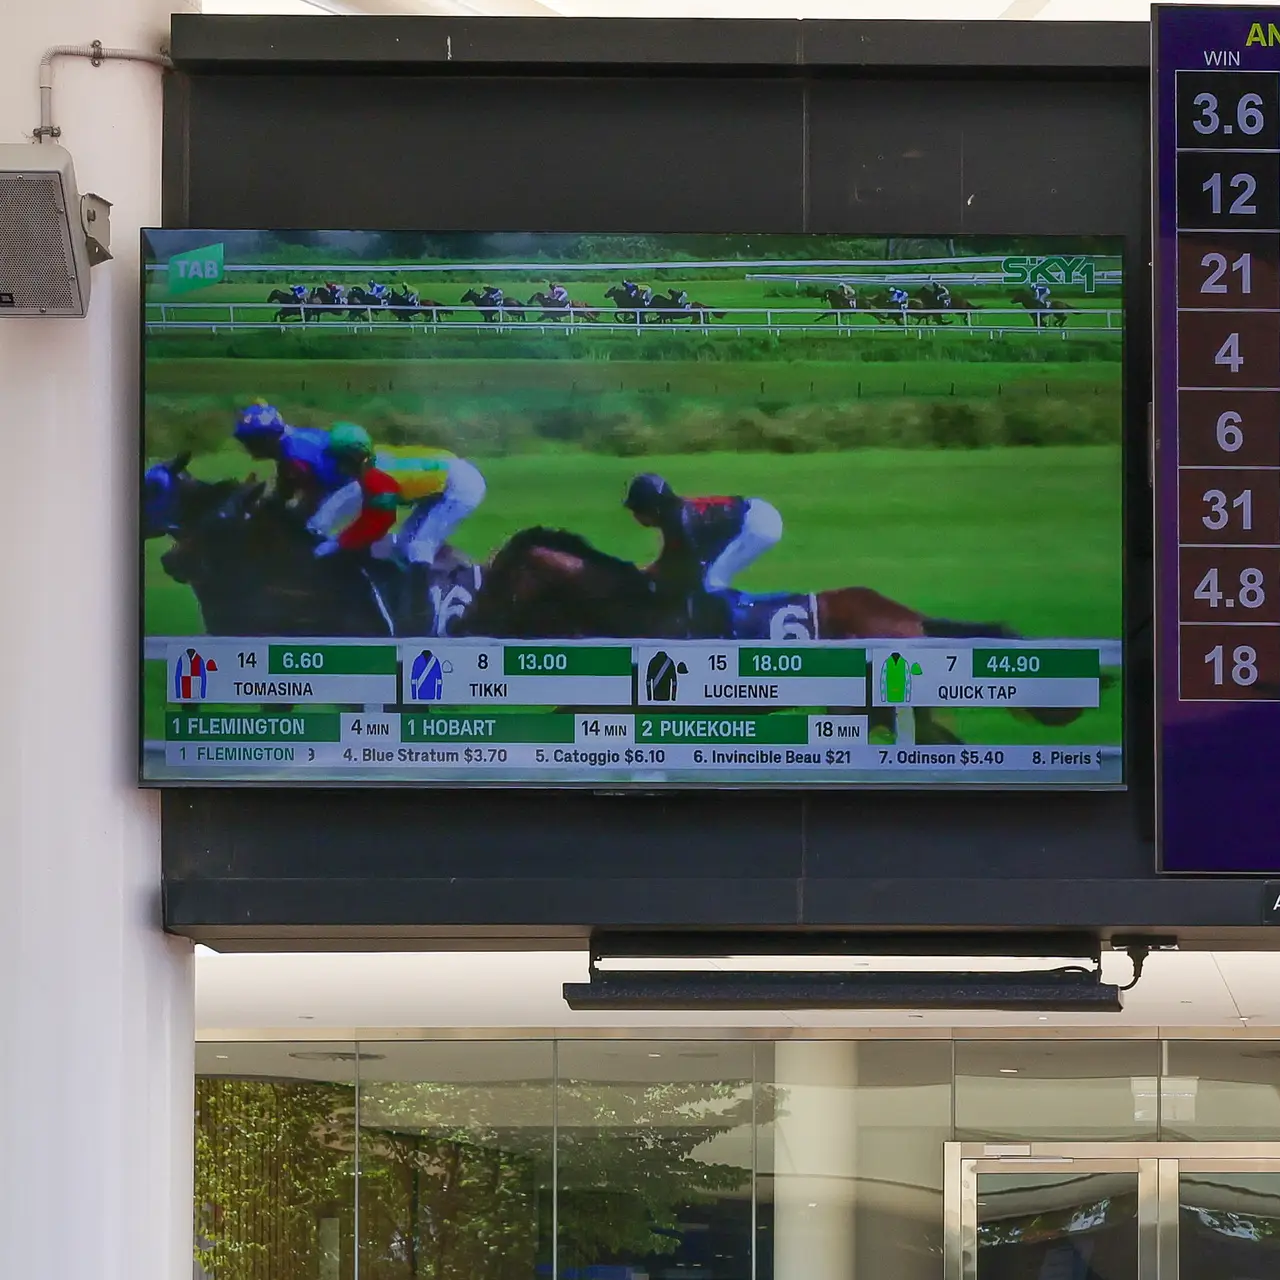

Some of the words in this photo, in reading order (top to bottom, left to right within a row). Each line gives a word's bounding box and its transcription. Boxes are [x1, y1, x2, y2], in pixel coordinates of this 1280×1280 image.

[1204, 51, 1240, 66] WIN
[1193, 93, 1264, 134] 3.6
[1202, 173, 1257, 214] 12
[175, 260, 218, 278] TAB
[237, 652, 257, 668] 14
[283, 653, 323, 669] 6.60
[477, 654, 488, 669] 8
[518, 654, 567, 670] 13.00
[708, 655, 727, 670] 15
[753, 655, 802, 671] 18.00
[947, 656, 957, 671] 7
[987, 657, 1040, 672] 44.90
[234, 682, 313, 697] TOMASINA
[470, 684, 507, 698] TIKKI
[704, 684, 778, 699] LUCIENNE
[938, 685, 986, 701] QUICK
[989, 686, 1016, 700] TAP
[173, 719, 180, 734] 1
[188, 718, 305, 735] FLEMINGTON
[351, 720, 362, 735] 4
[367, 724, 389, 735] MIN
[408, 721, 415, 735] 1
[423, 720, 496, 735] HOBART
[582, 720, 600, 736] 14
[605, 725, 627, 737] MIN
[642, 721, 652, 737] 2
[661, 721, 756, 737] PUKEKOHE
[815, 722, 833, 737] 18
[838, 726, 859, 737] MIN
[198, 748, 294, 761] FLEMINGTON
[344, 749, 357, 762] 4.
[362, 749, 393, 762] Blue
[398, 749, 459, 763] Stratum
[464, 748, 507, 764] $3.70
[536, 750, 549, 763] 5.
[554, 750, 620, 766] Catoggio
[625, 749, 665, 765] $6.10
[694, 751, 708, 764] 6.
[712, 750, 782, 764] Invincible
[786, 751, 821, 764] Beau
[826, 750, 850, 766] $21
[879, 751, 892, 765] 7.
[897, 751, 955, 765] Odinson
[960, 750, 1004, 766] $5.40
[1033, 752, 1046, 765] 8.
[1051, 751, 1091, 765] Pieris
